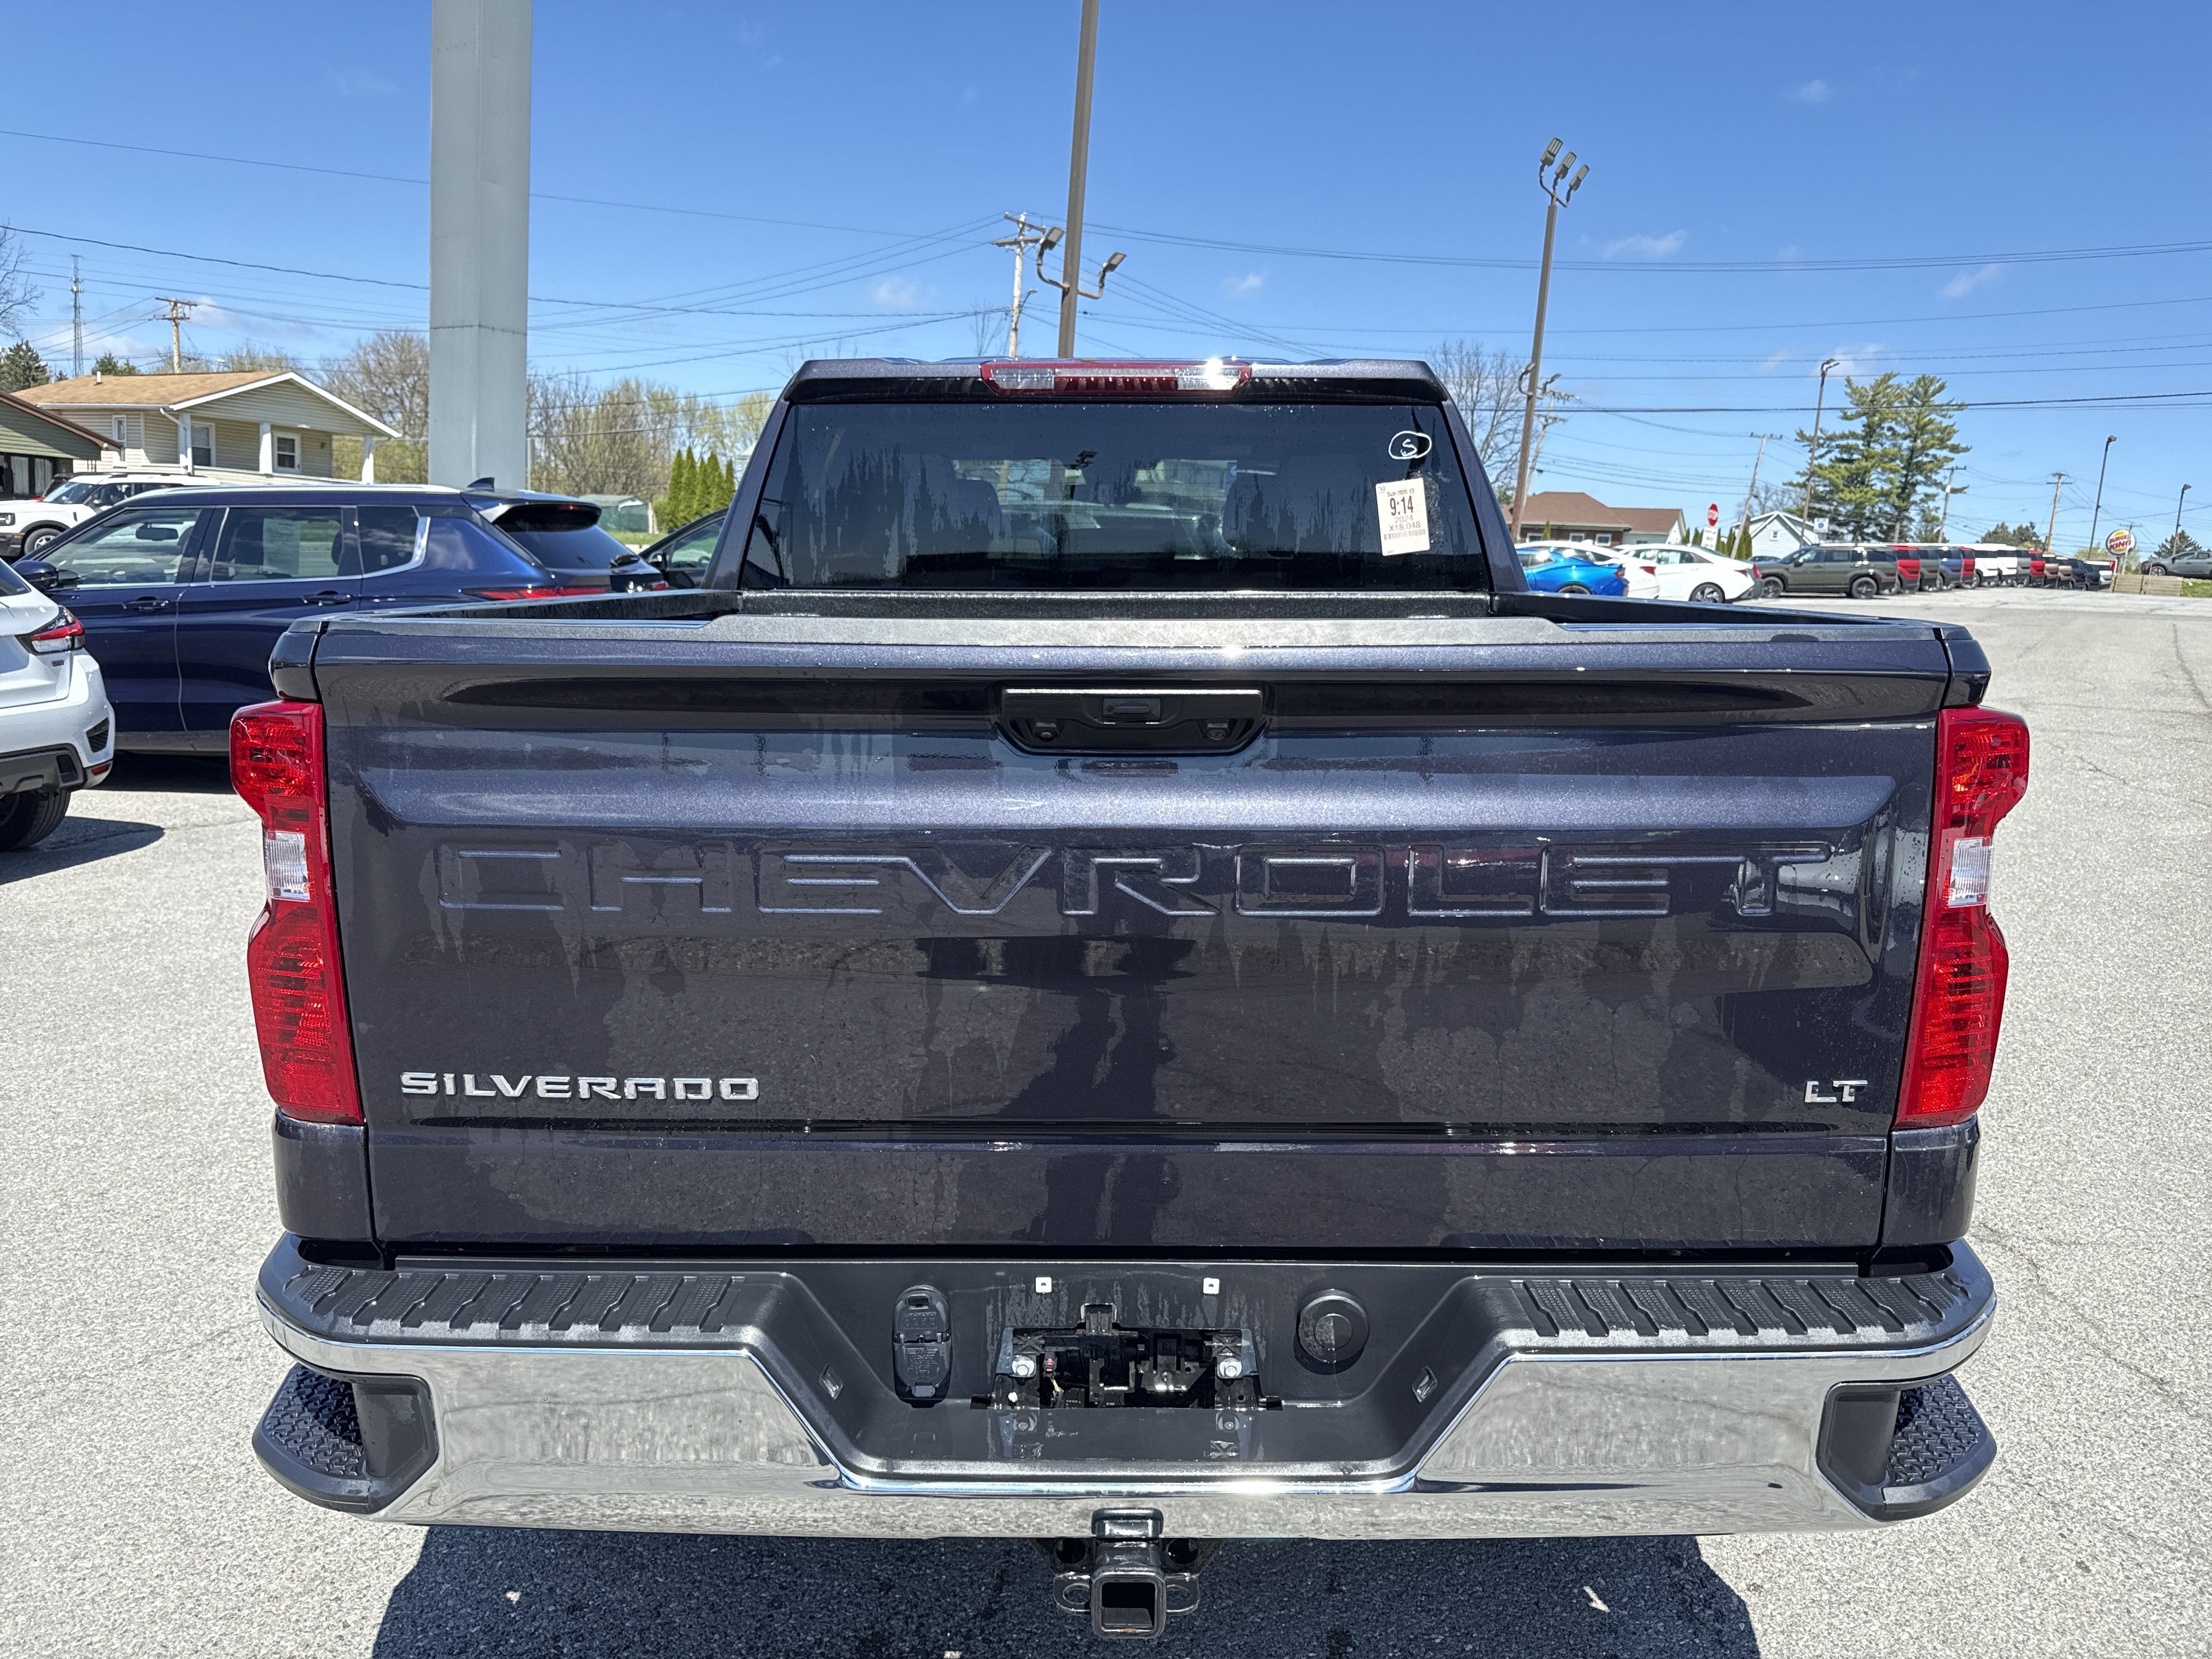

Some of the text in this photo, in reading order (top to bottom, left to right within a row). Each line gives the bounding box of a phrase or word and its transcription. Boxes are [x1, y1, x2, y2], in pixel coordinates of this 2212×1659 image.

[1390, 495, 1414, 516] 9:14
[1708, 509, 1718, 520] STOP
[1389, 521, 1421, 532] X18 048
[1394, 515, 1414, 524] 2024
[435, 839, 1835, 919] CHEVROLET
[400, 1071, 759, 1099] SILVERADO
[1804, 1080, 1869, 1103] LT
